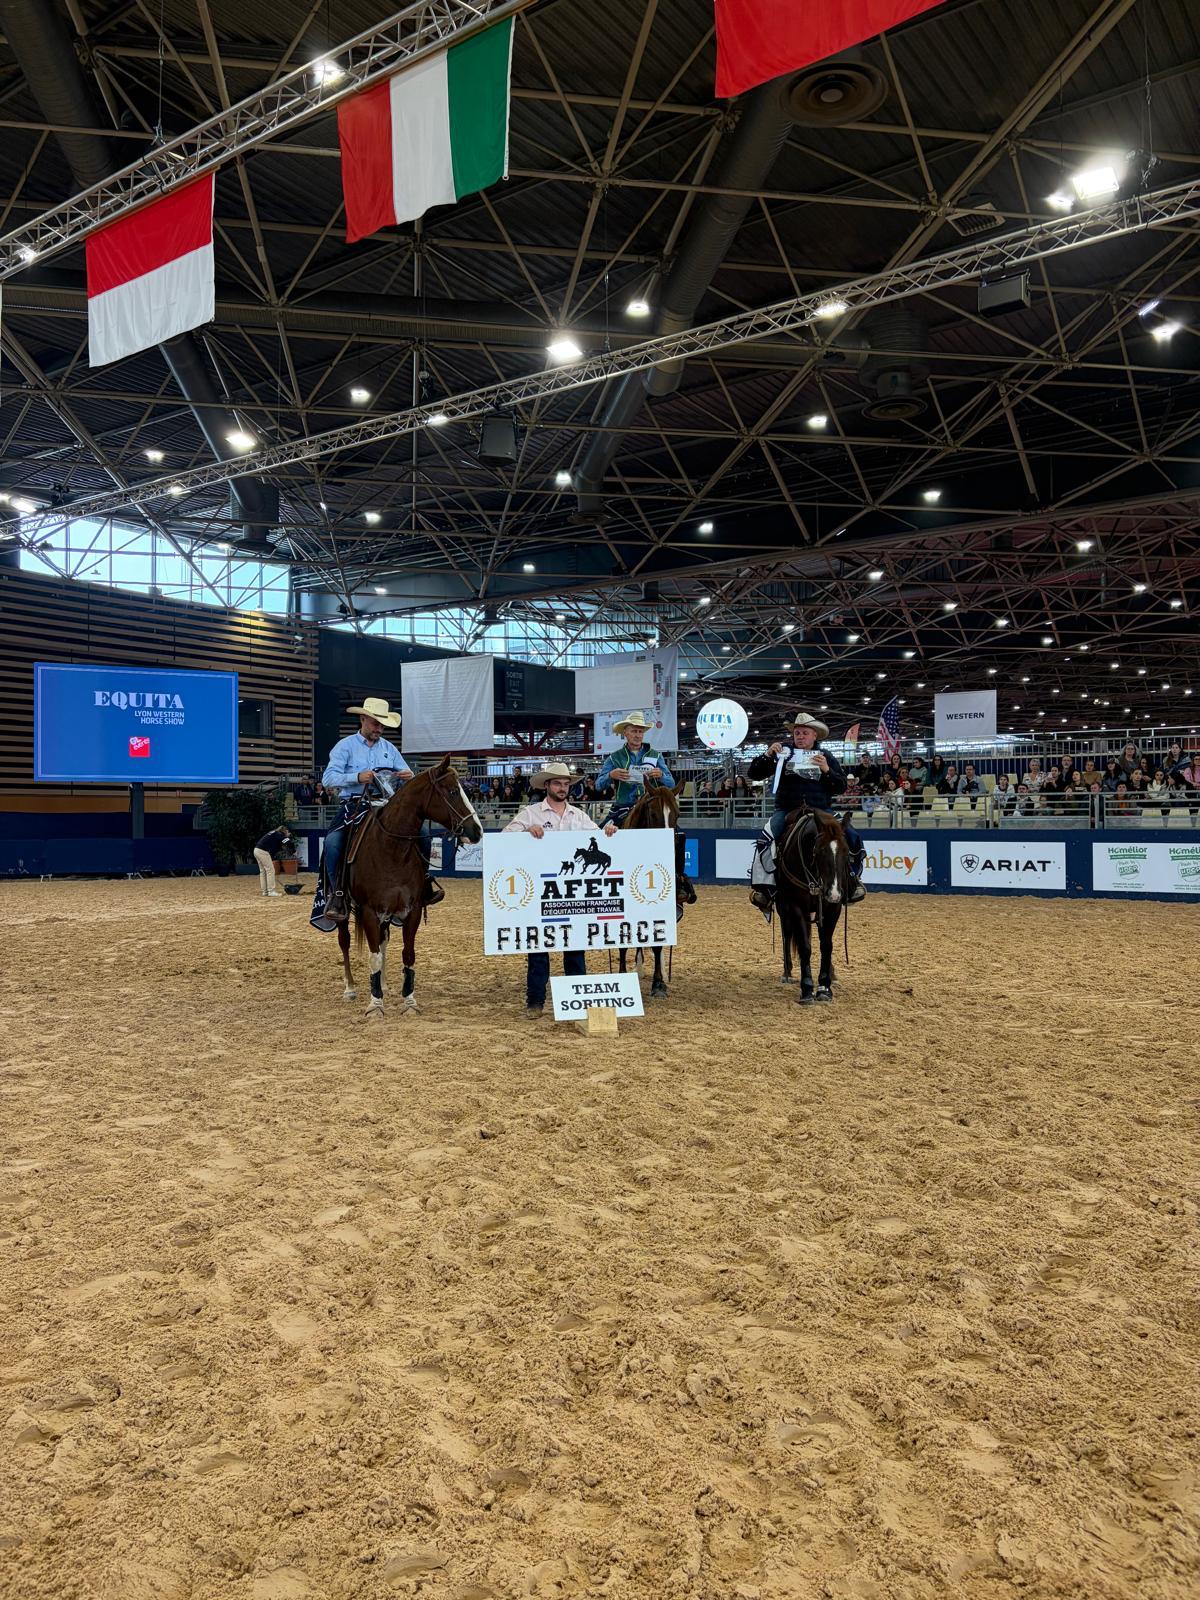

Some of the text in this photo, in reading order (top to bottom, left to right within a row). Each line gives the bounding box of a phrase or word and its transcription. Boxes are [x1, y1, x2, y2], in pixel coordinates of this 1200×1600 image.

[94, 691, 184, 709] EQUITA
[946, 712, 985, 720] WESTERN
[1107, 846, 1148, 854] Homélior
[981, 859, 1051, 873] ARIAT
[506, 875, 518, 896] 1
[645, 870, 656, 890] 1
[541, 878, 624, 900] AFET
[544, 900, 621, 909] ASSOCIATION FRANÇAISE
[596, 905, 622, 914] TRAVAIL
[497, 920, 667, 950] FIRST PLACE
[572, 982, 620, 994] TEAM
[561, 997, 635, 1011] SORTING
